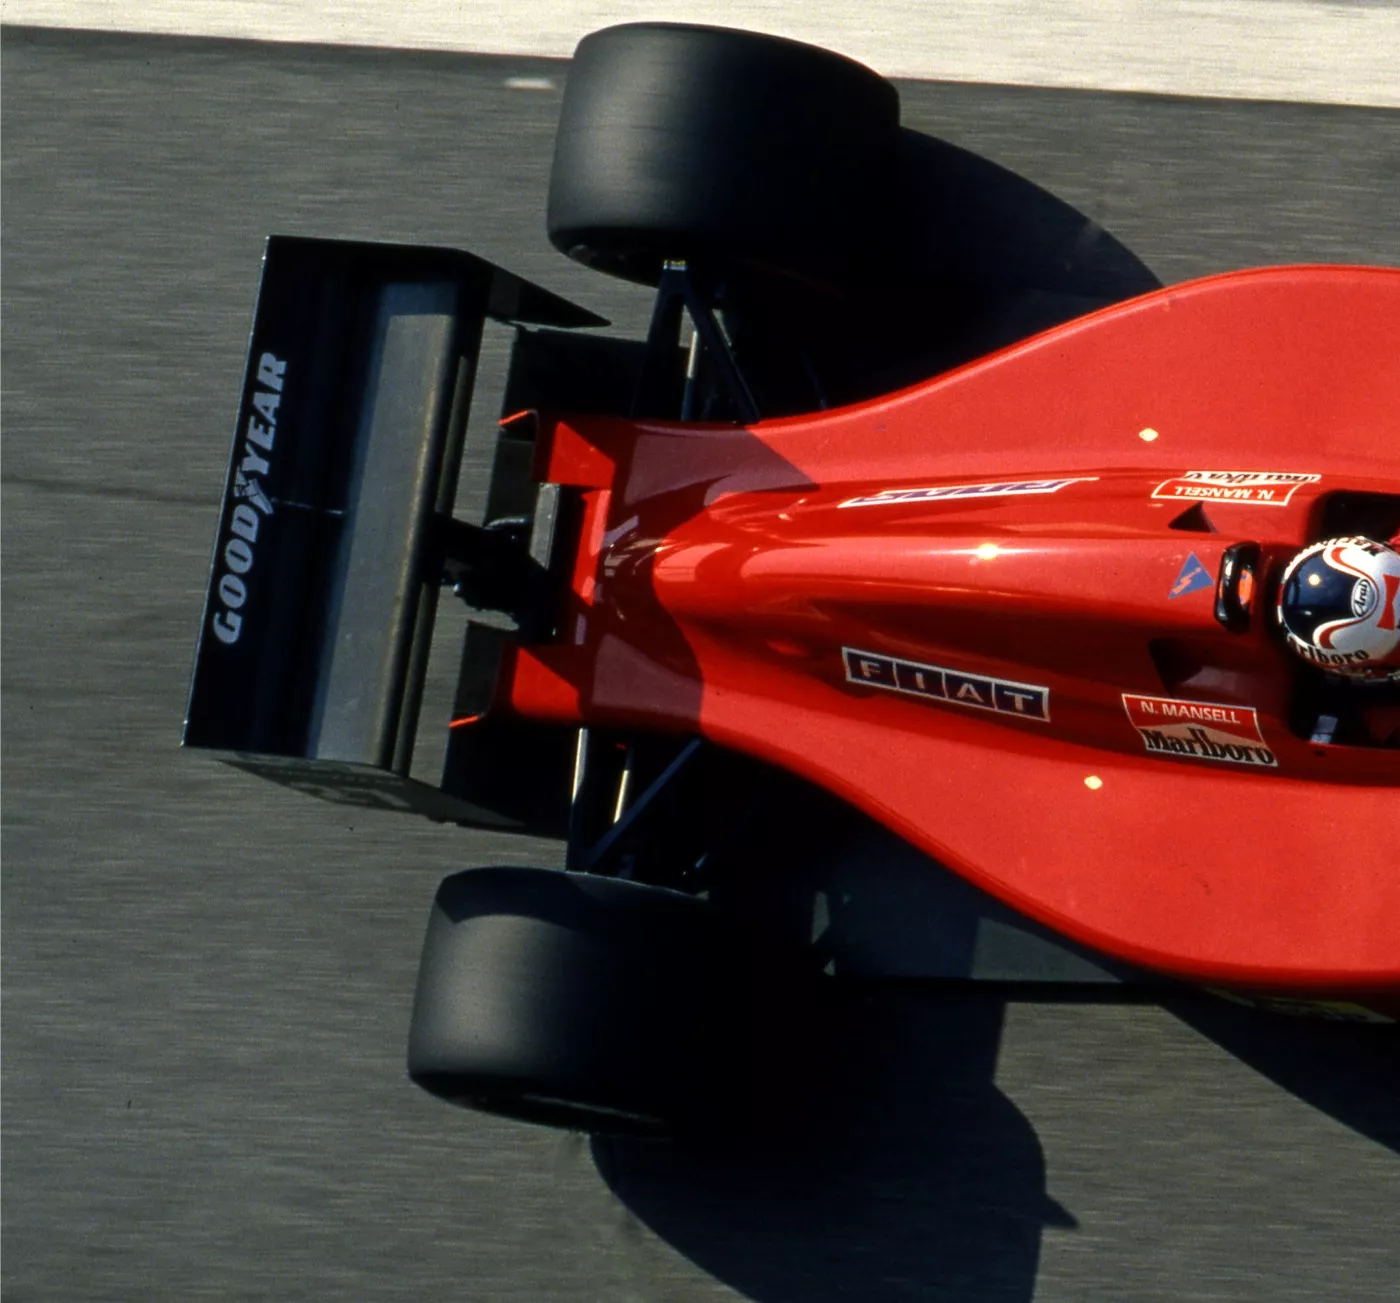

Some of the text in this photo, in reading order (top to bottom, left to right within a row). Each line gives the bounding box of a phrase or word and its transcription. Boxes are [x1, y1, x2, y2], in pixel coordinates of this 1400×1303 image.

[213, 353, 287, 645] GOODYEAR
[1174, 486, 1253, 500] MANSELL
[1354, 582, 1368, 617] Arai
[860, 660, 1034, 711] FIAT
[1141, 700, 1241, 724] N. MANSELL
[1140, 728, 1275, 765] Marlboro
